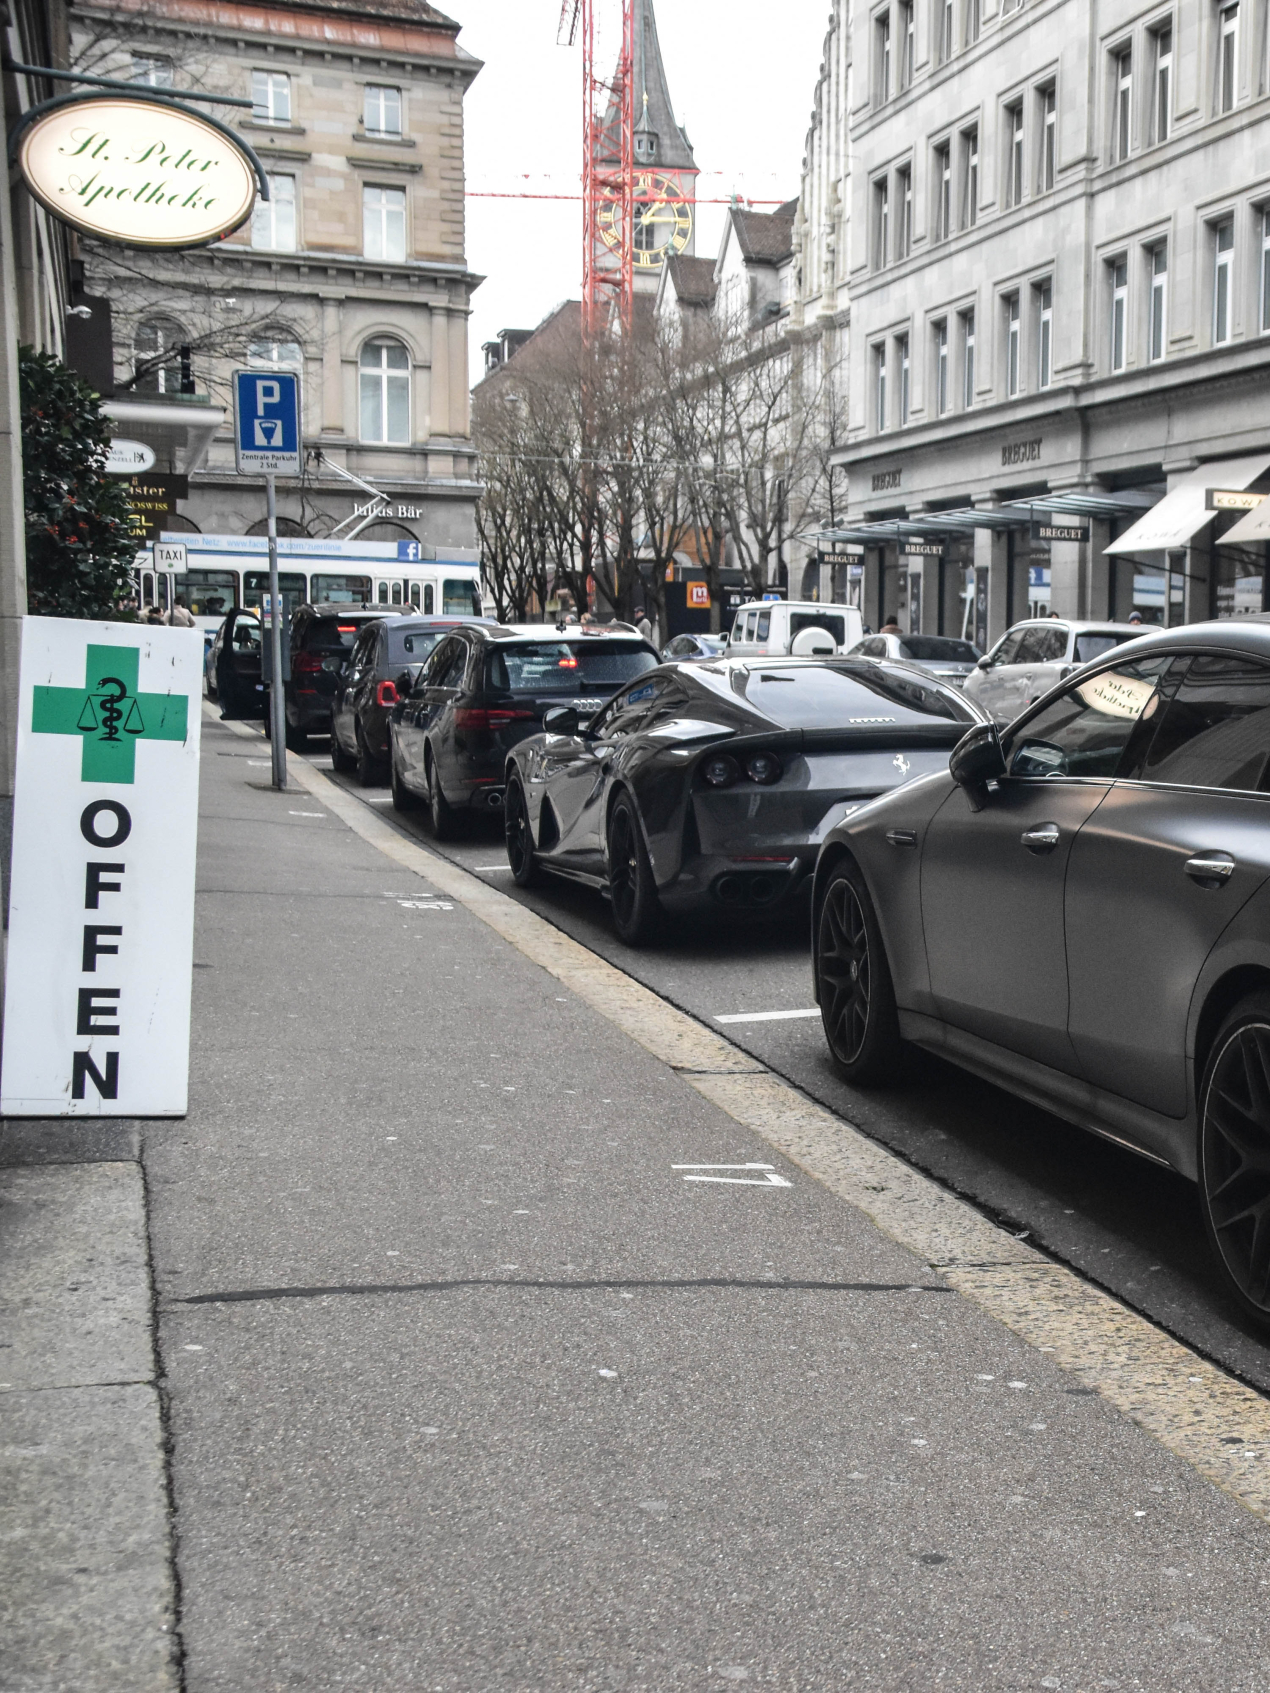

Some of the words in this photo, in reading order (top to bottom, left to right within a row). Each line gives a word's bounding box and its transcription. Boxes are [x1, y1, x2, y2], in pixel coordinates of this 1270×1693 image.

[58, 127, 110, 159] St.
[124, 140, 219, 172] Peter
[58, 170, 219, 210] Apotheke
[256, 380, 280, 416] P
[241, 453, 269, 461] Zentrale
[271, 454, 297, 462] Parkuhr
[1001, 437, 1043, 466] BREGUET
[871, 468, 903, 492] BREGUET
[125, 501, 169, 511] NOSWISS
[398, 505, 423, 518] Bär
[1039, 527, 1083, 539] BREGUET
[159, 549, 182, 561] TAXI
[905, 544, 943, 555] BREGUET
[824, 554, 858, 564] BREGUET
[71, 799, 132, 1100] OFFEN
